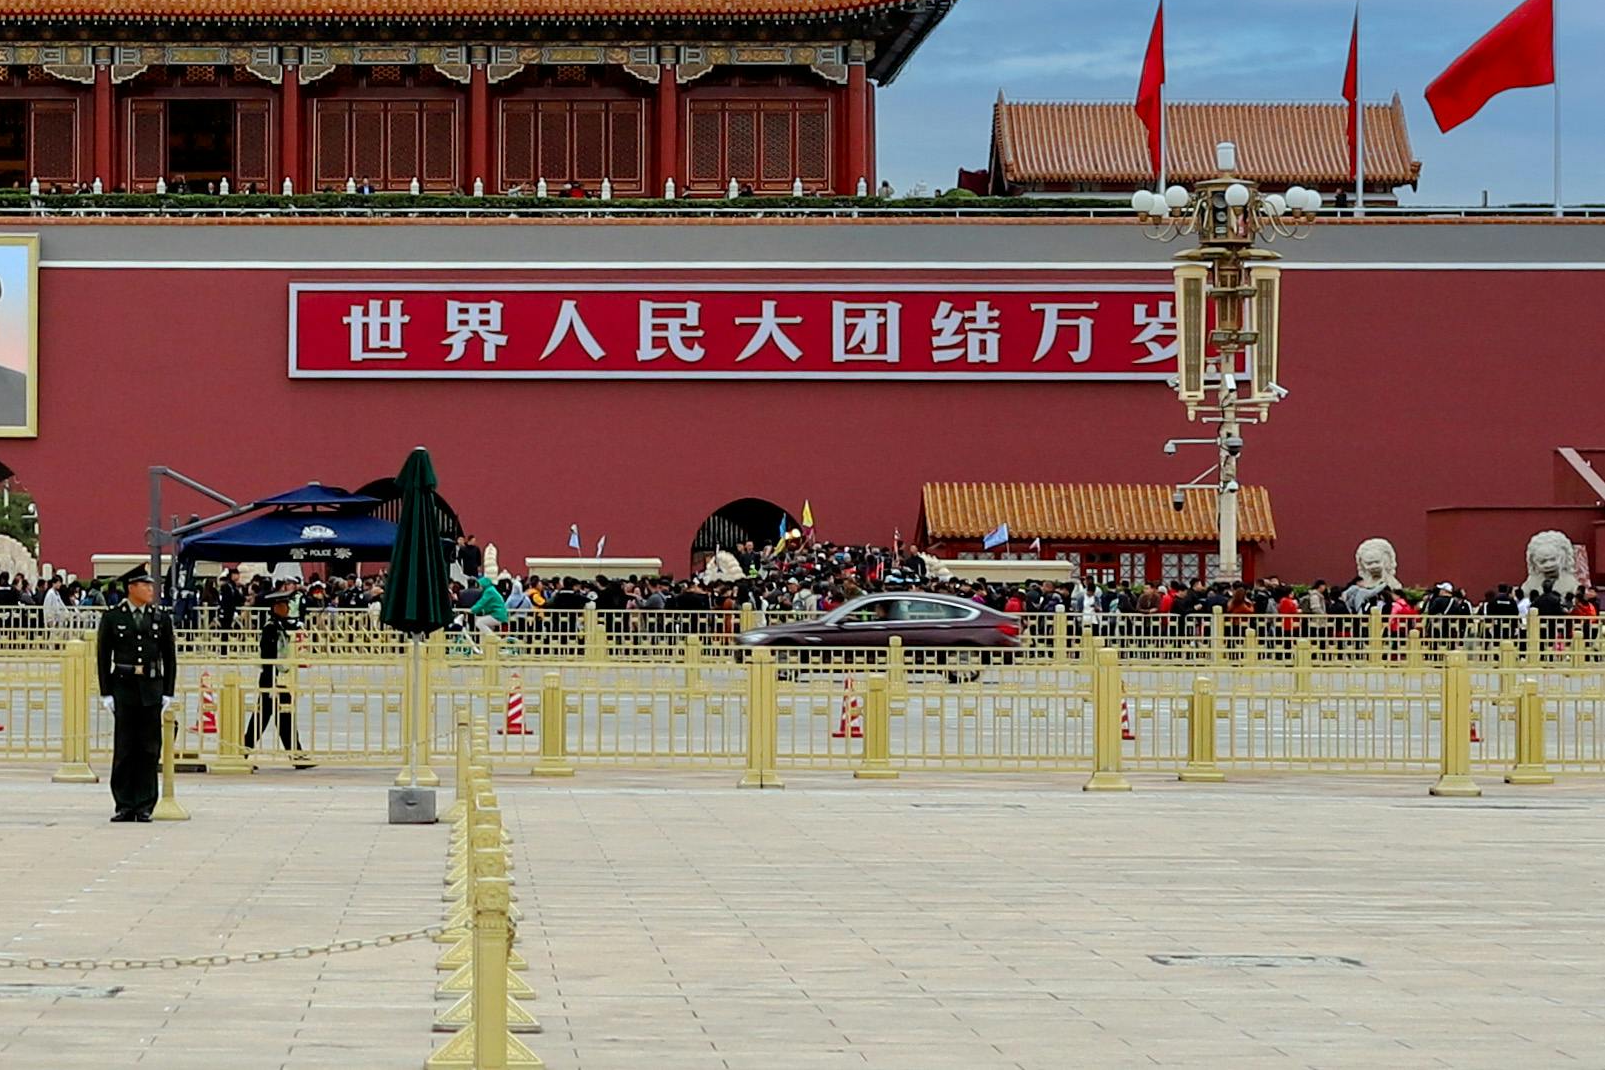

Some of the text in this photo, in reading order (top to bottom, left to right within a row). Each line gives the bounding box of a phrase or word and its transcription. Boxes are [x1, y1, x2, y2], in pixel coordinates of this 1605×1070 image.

[342, 299, 1179, 364] 世界人民大团结万岁
[309, 549, 332, 557] POLICE
